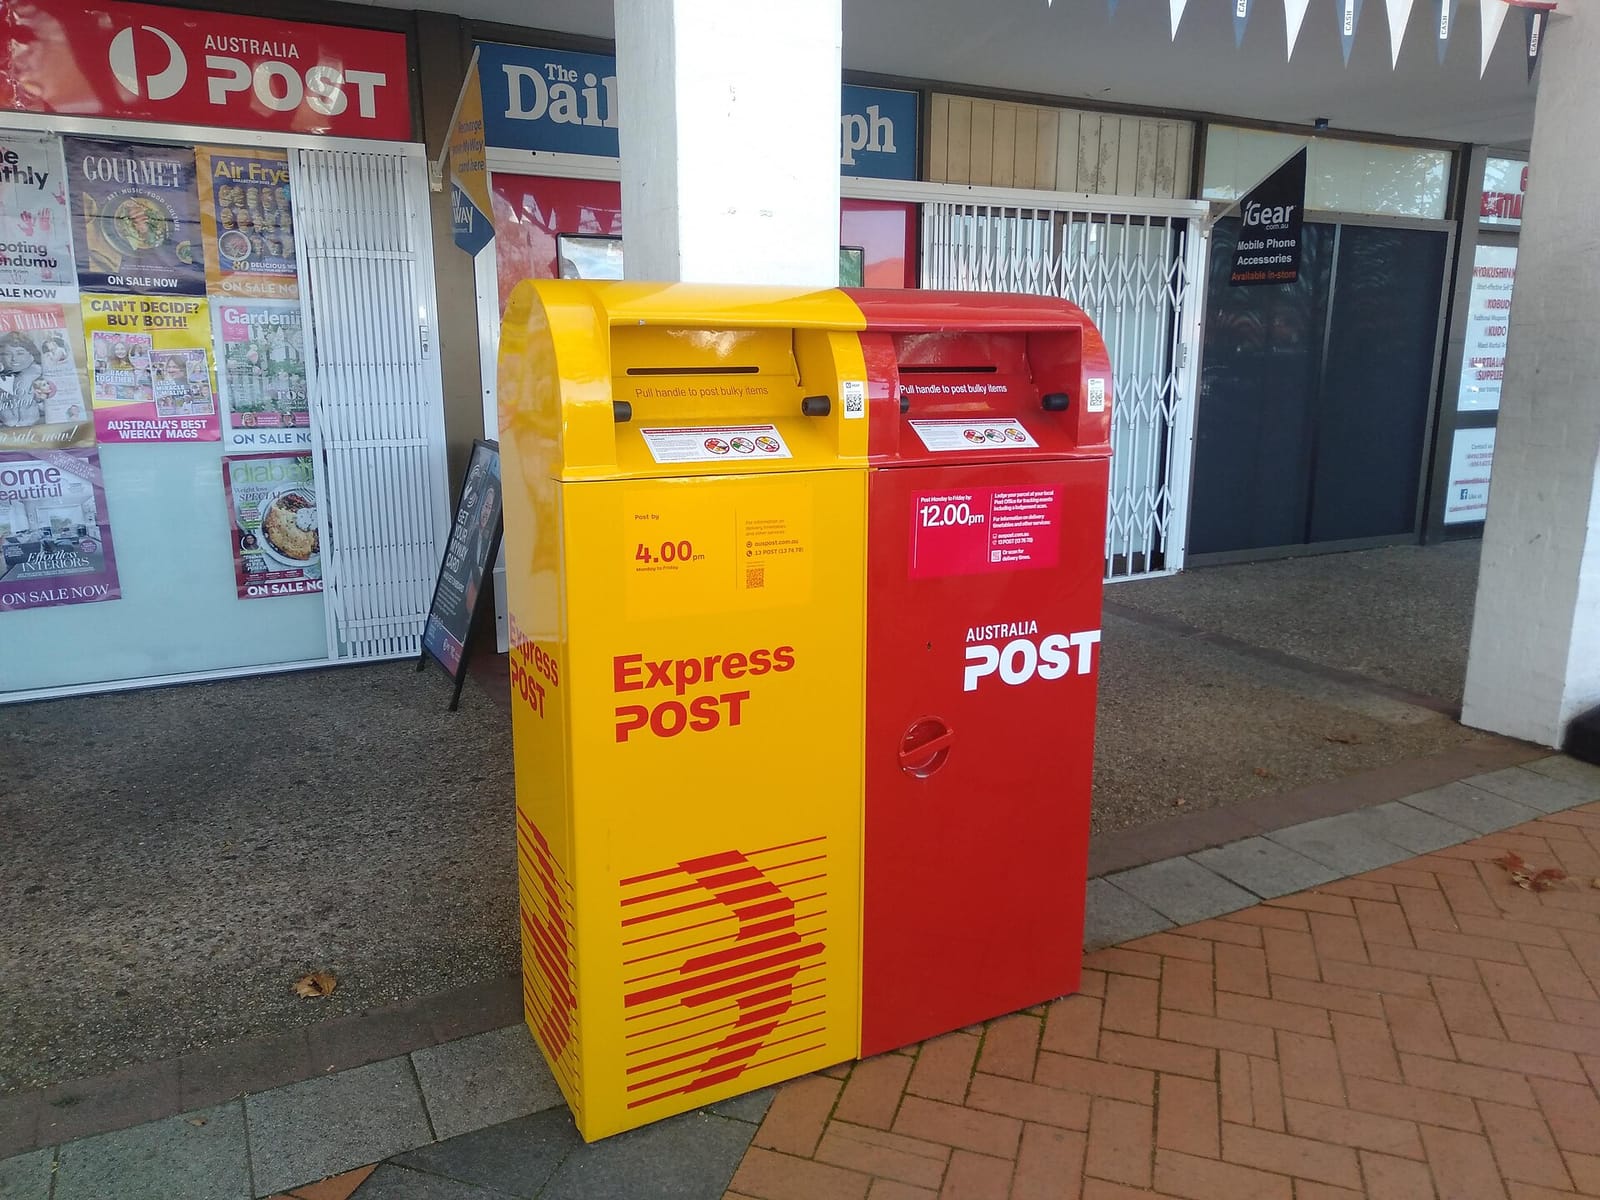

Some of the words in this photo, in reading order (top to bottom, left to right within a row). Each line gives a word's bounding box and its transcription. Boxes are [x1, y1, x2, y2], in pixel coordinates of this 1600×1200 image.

[204, 34, 300, 60] AUSTRALIA
[1530, 33, 1538, 52] CASH
[544, 63, 578, 83] The
[205, 55, 387, 119] POST
[502, 63, 618, 128] Dail
[82, 155, 182, 189] GOURMET
[214, 160, 244, 179] Air
[147, 191, 165, 203] FOOD
[166, 204, 180, 232] CULTURE
[452, 206, 474, 233] WAY
[1242, 200, 1294, 227] iGear
[1237, 240, 1265, 250] Mobile
[1266, 238, 1296, 249] Phone
[232, 260, 249, 271] 80
[251, 262, 286, 270] DELICIOUS
[1236, 254, 1292, 265] Accessories
[107, 276, 124, 286] ON
[126, 277, 151, 287] SALE
[153, 278, 178, 288] NOW
[1231, 271, 1267, 281] Available
[23, 289, 57, 299] NOW
[222, 282, 243, 291] ON
[245, 283, 272, 293] SALE
[91, 300, 136, 312] CAN'T
[140, 302, 200, 314] DECIDE?
[14, 311, 59, 330] WEEKLY
[107, 314, 139, 327] BUY
[143, 316, 188, 327] BOTH!
[1488, 326, 1507, 336] KUDO
[635, 388, 654, 398] Pull
[655, 387, 686, 398] handle
[688, 388, 698, 397] to
[700, 387, 719, 398] post
[720, 386, 744, 398] bulky
[745, 386, 769, 396] items
[900, 385, 914, 394] Pull
[916, 384, 941, 394] handle
[942, 384, 950, 394] to
[951, 384, 967, 395] post
[967, 384, 987, 395] bulky
[987, 383, 1008, 393] items
[13, 428, 36, 443] sale
[41, 424, 79, 443] now!
[107, 419, 179, 431] AUSTRALIA'S
[181, 419, 208, 429] BEST
[119, 430, 162, 440] WEEKLY
[165, 429, 198, 439] MAGS
[233, 434, 254, 445] ON
[256, 433, 292, 444] SALE
[239, 491, 281, 501] SPECIAL
[651, 513, 660, 521] by
[22, 557, 90, 572] INTERIORS
[2, 592, 27, 606] ON
[29, 588, 69, 602] SALE
[71, 583, 110, 599] NOW
[247, 585, 268, 596] ON
[271, 582, 304, 594] SALE
[966, 620, 1039, 643] AUSTRALIA
[509, 611, 559, 688] Express
[963, 630, 1102, 692] POST
[612, 646, 796, 696] Express
[511, 656, 545, 720] POST
[615, 690, 750, 743] POST
